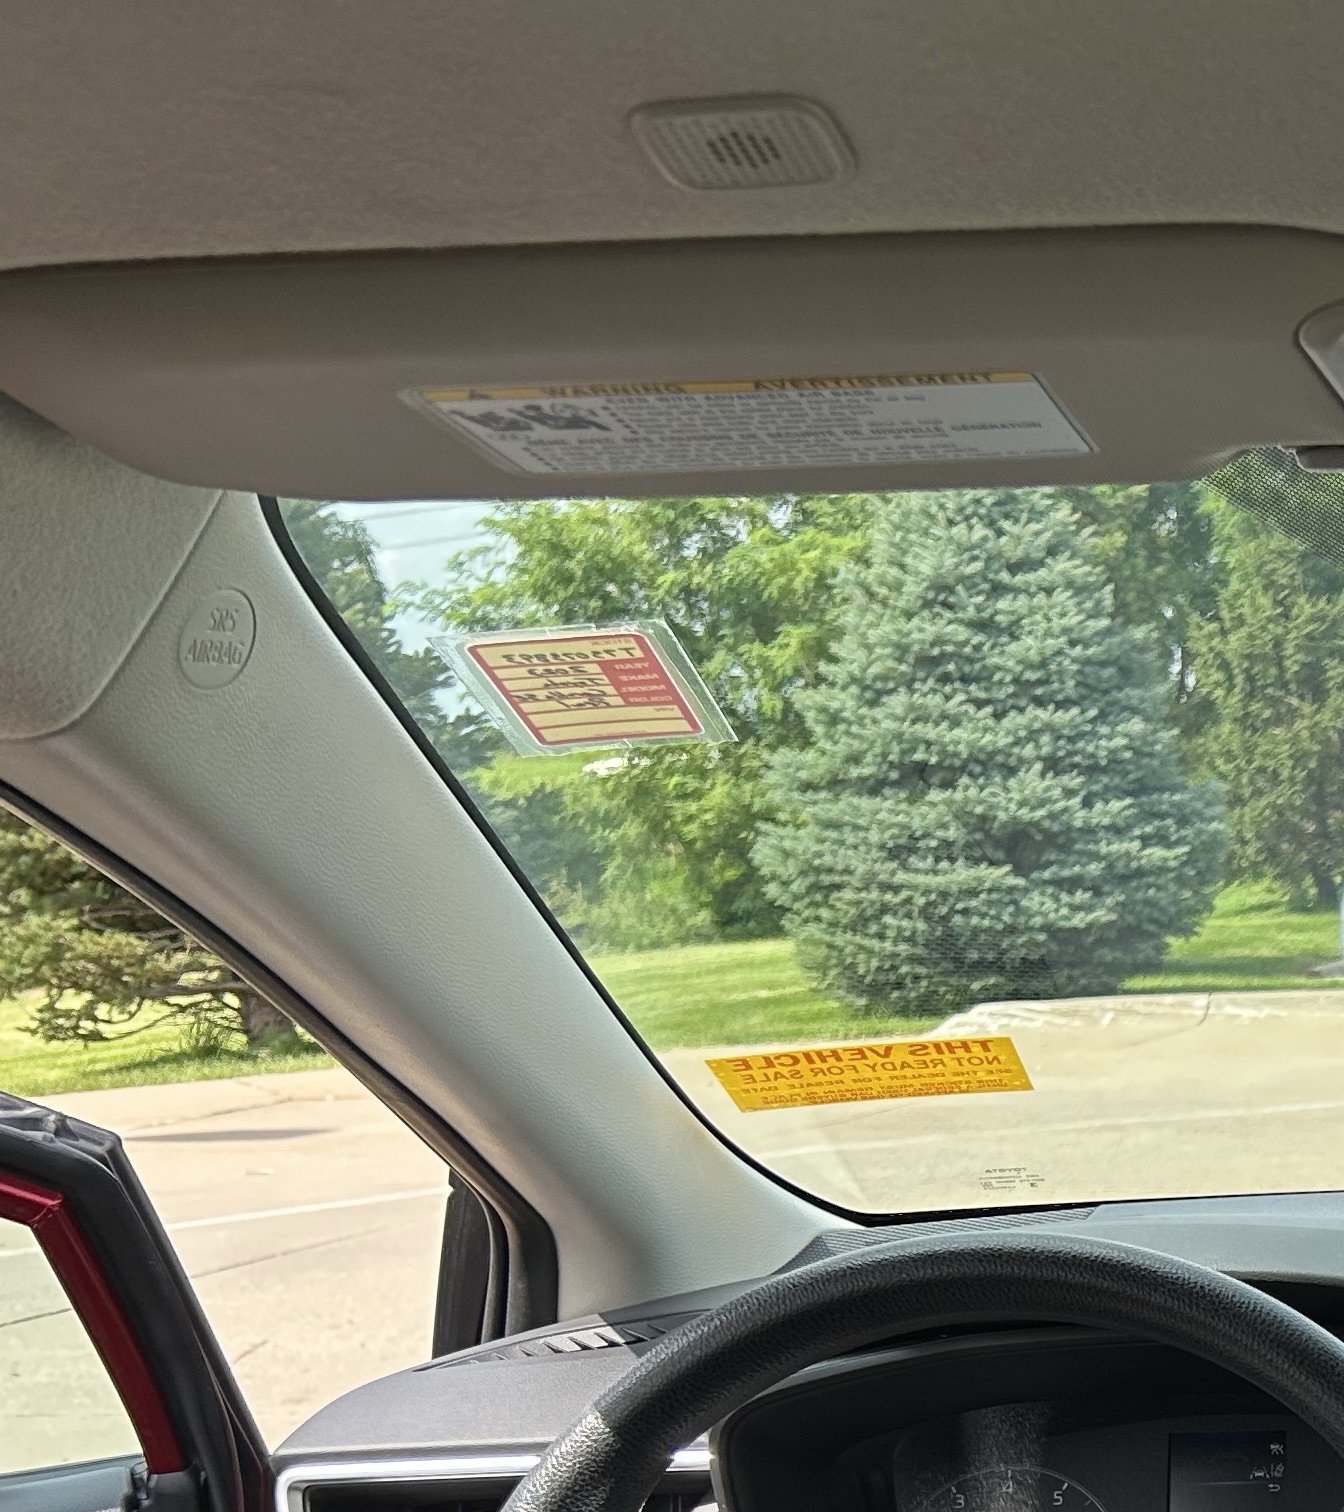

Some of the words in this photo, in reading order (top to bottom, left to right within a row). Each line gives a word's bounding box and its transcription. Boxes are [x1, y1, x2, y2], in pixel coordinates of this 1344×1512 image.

[1001, 1480, 1014, 1494] 4
[955, 1494, 965, 1509] 3
[1053, 1491, 1064, 1506] 5
